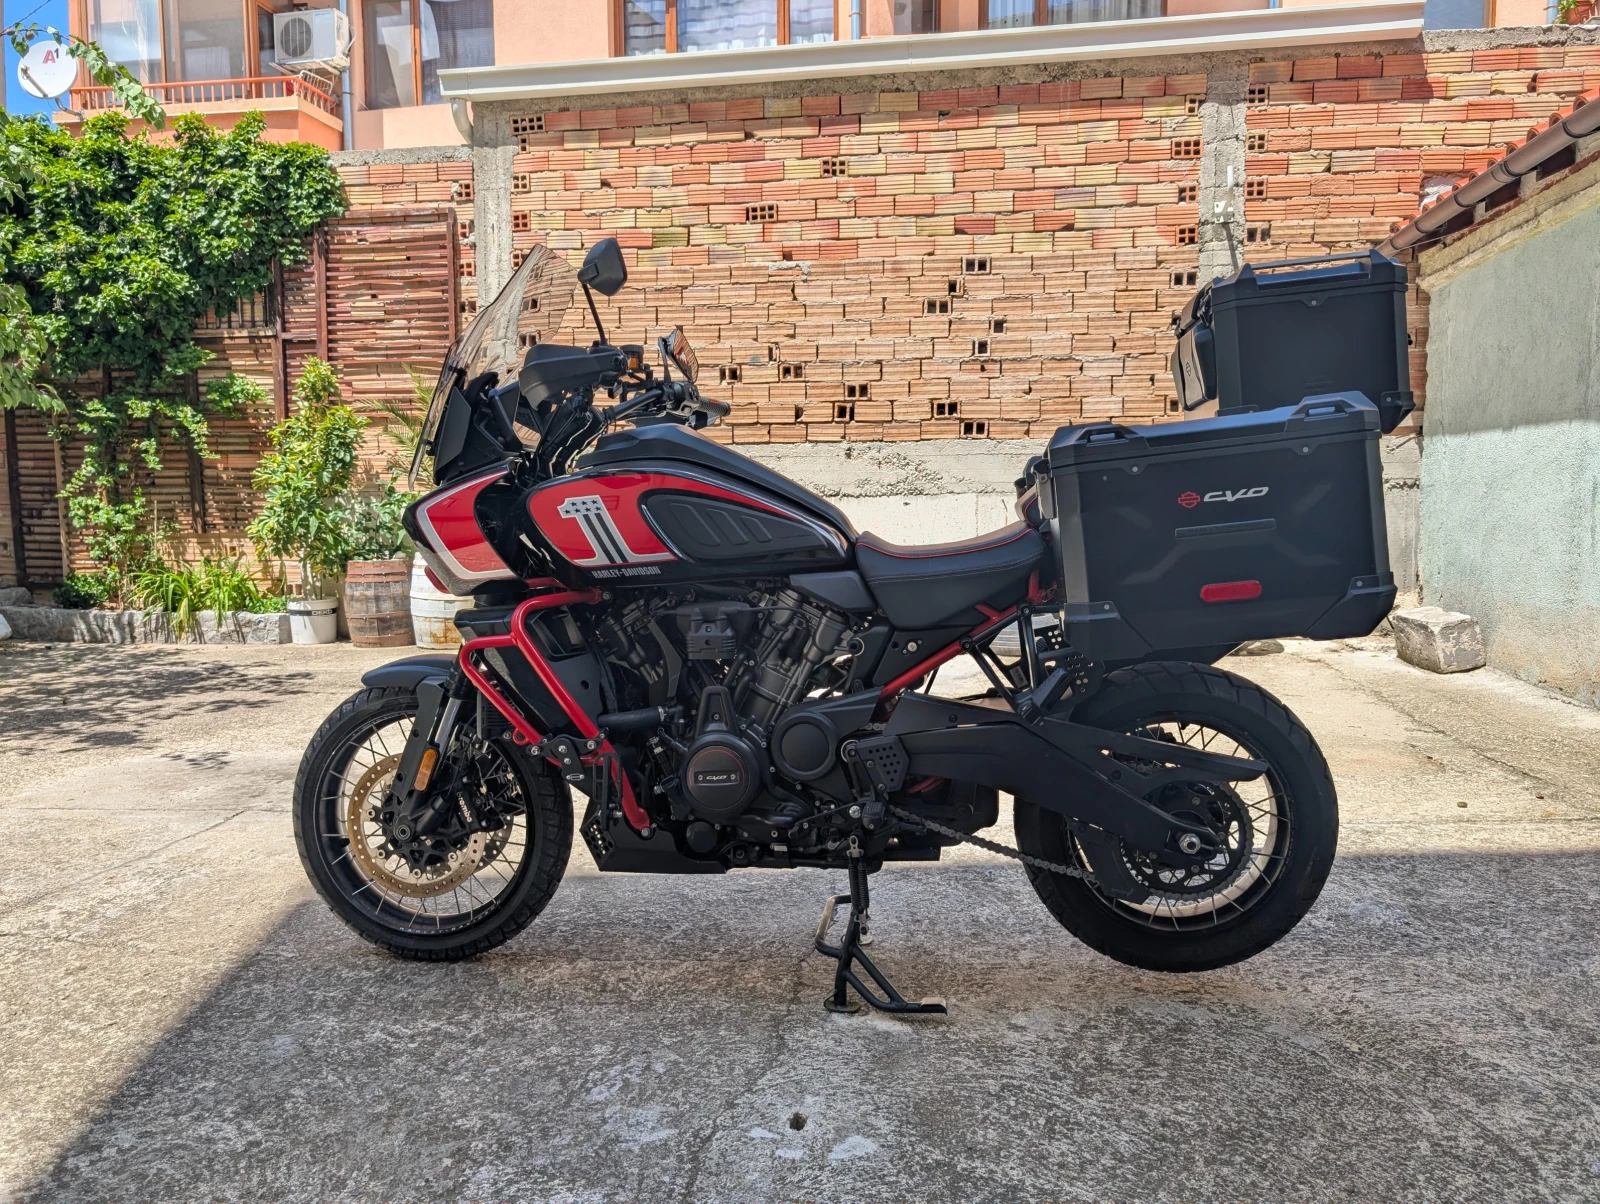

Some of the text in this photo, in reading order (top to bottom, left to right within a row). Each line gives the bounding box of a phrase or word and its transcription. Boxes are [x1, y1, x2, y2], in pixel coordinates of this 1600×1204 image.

[43, 48, 59, 64] A1
[1203, 486, 1270, 502] CVO
[591, 566, 662, 579] HARLEY-DAVIDSON
